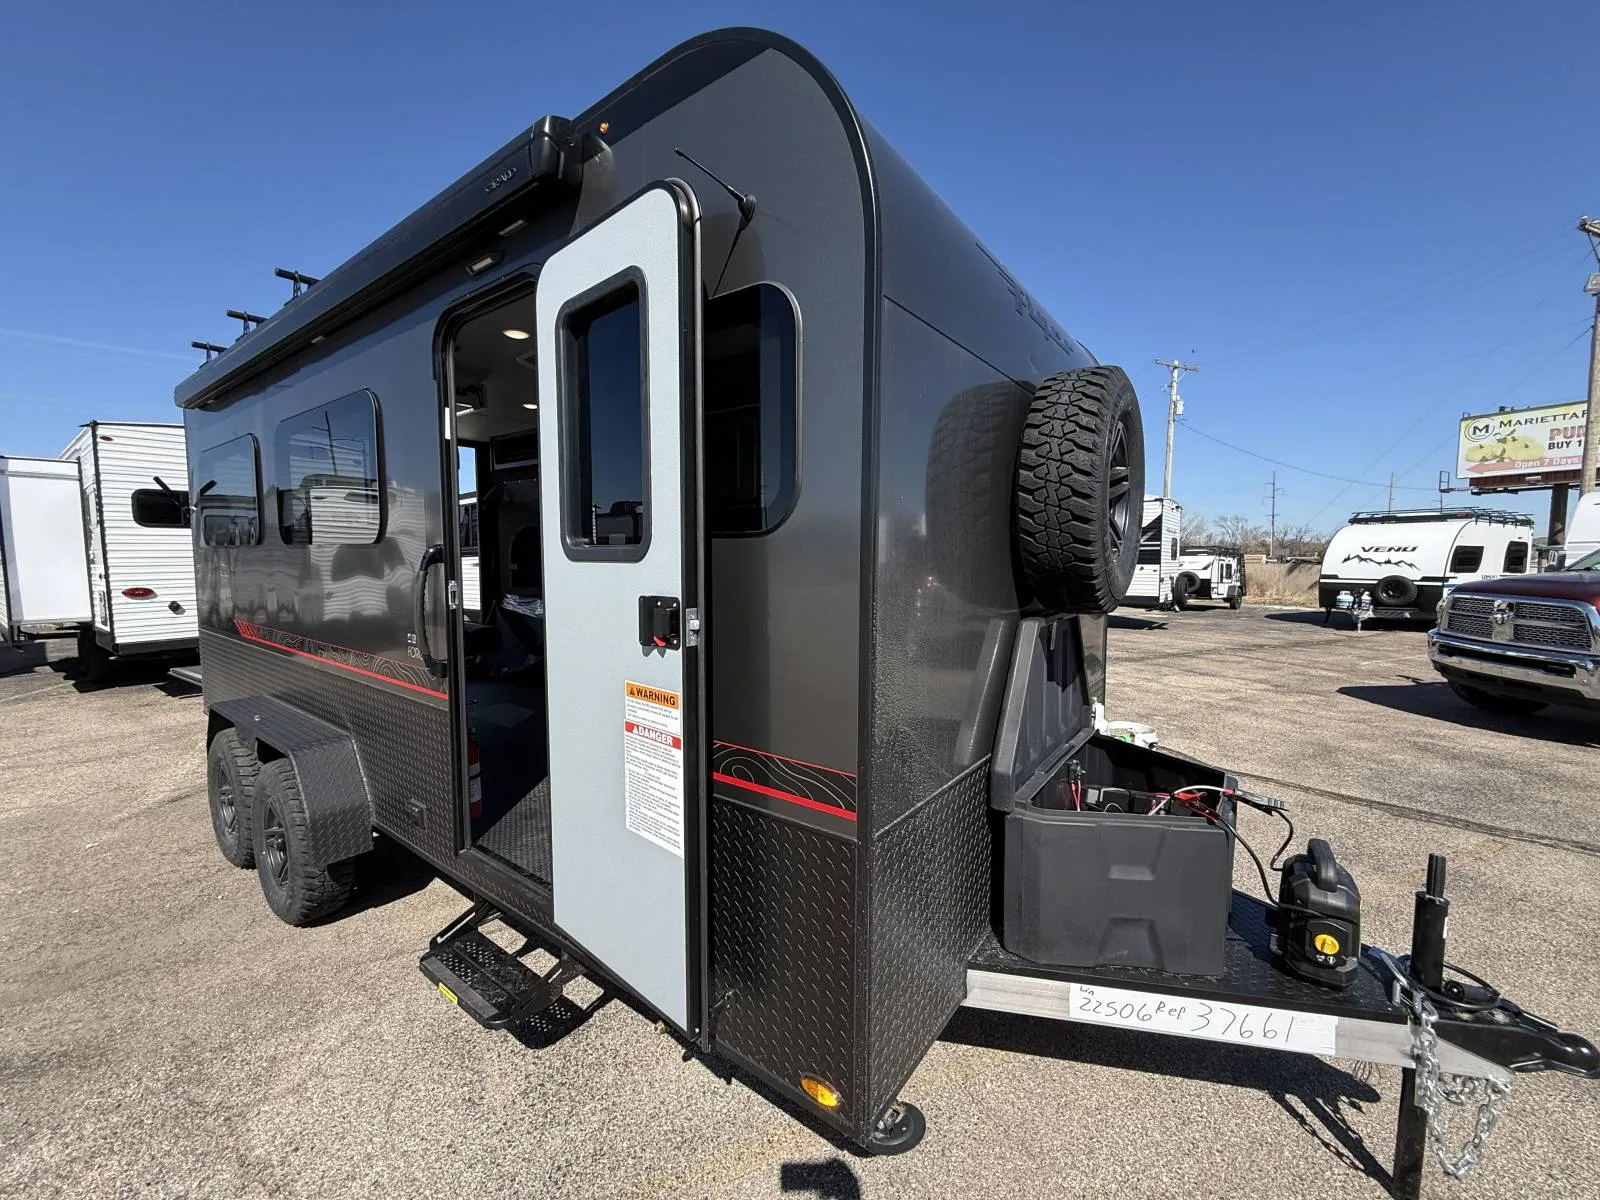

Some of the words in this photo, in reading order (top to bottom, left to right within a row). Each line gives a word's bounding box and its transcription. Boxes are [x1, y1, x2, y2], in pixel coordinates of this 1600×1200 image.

[1548, 440, 1571, 450] BUY
[1514, 458, 1541, 469] Open
[1360, 545, 1418, 553] VENU
[636, 687, 676, 706] WARNING
[638, 725, 673, 747] DANGER
[1079, 997, 1152, 1021] 22506
[1190, 1002, 1295, 1042] 37661
